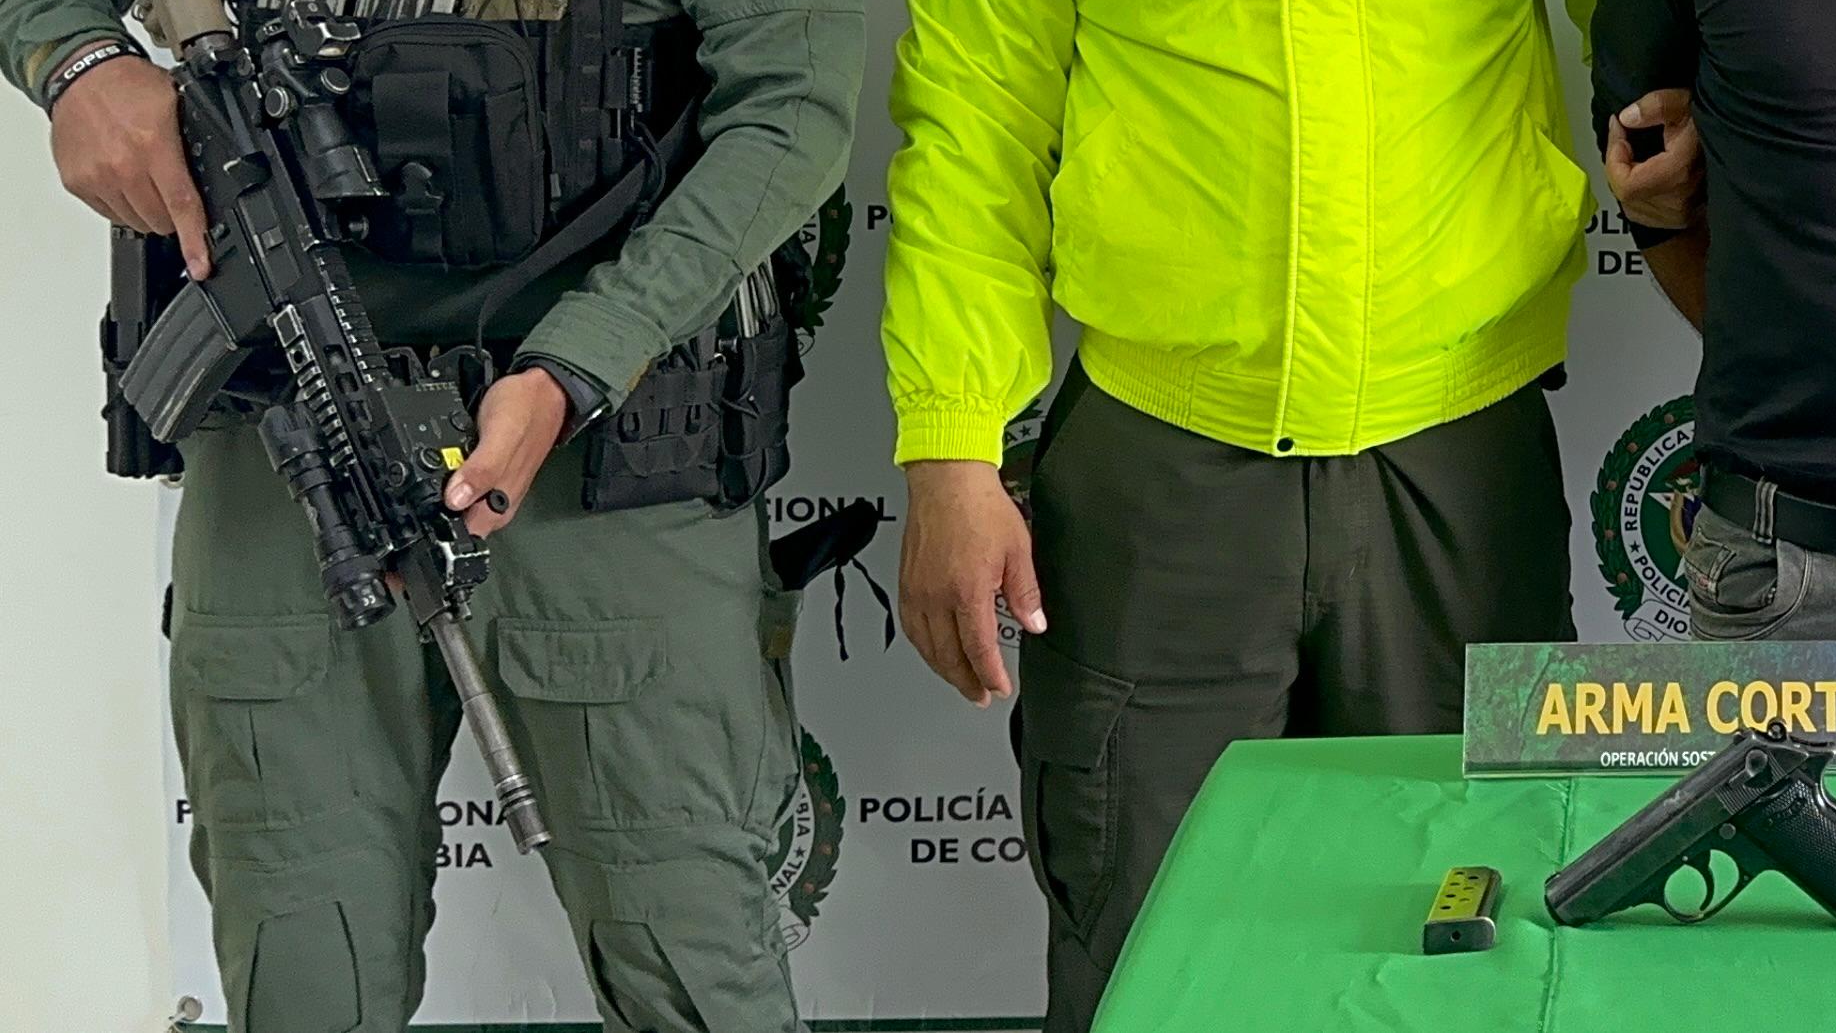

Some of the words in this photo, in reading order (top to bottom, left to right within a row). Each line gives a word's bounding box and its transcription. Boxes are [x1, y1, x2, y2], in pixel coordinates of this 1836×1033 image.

[63, 45, 121, 80] COPES
[1599, 251, 1642, 275] DE
[1537, 681, 1690, 734] ARMA
[1600, 747, 1679, 767] OPERACIÓN
[861, 788, 1012, 822] POLICÍA
[912, 839, 958, 863] DE
